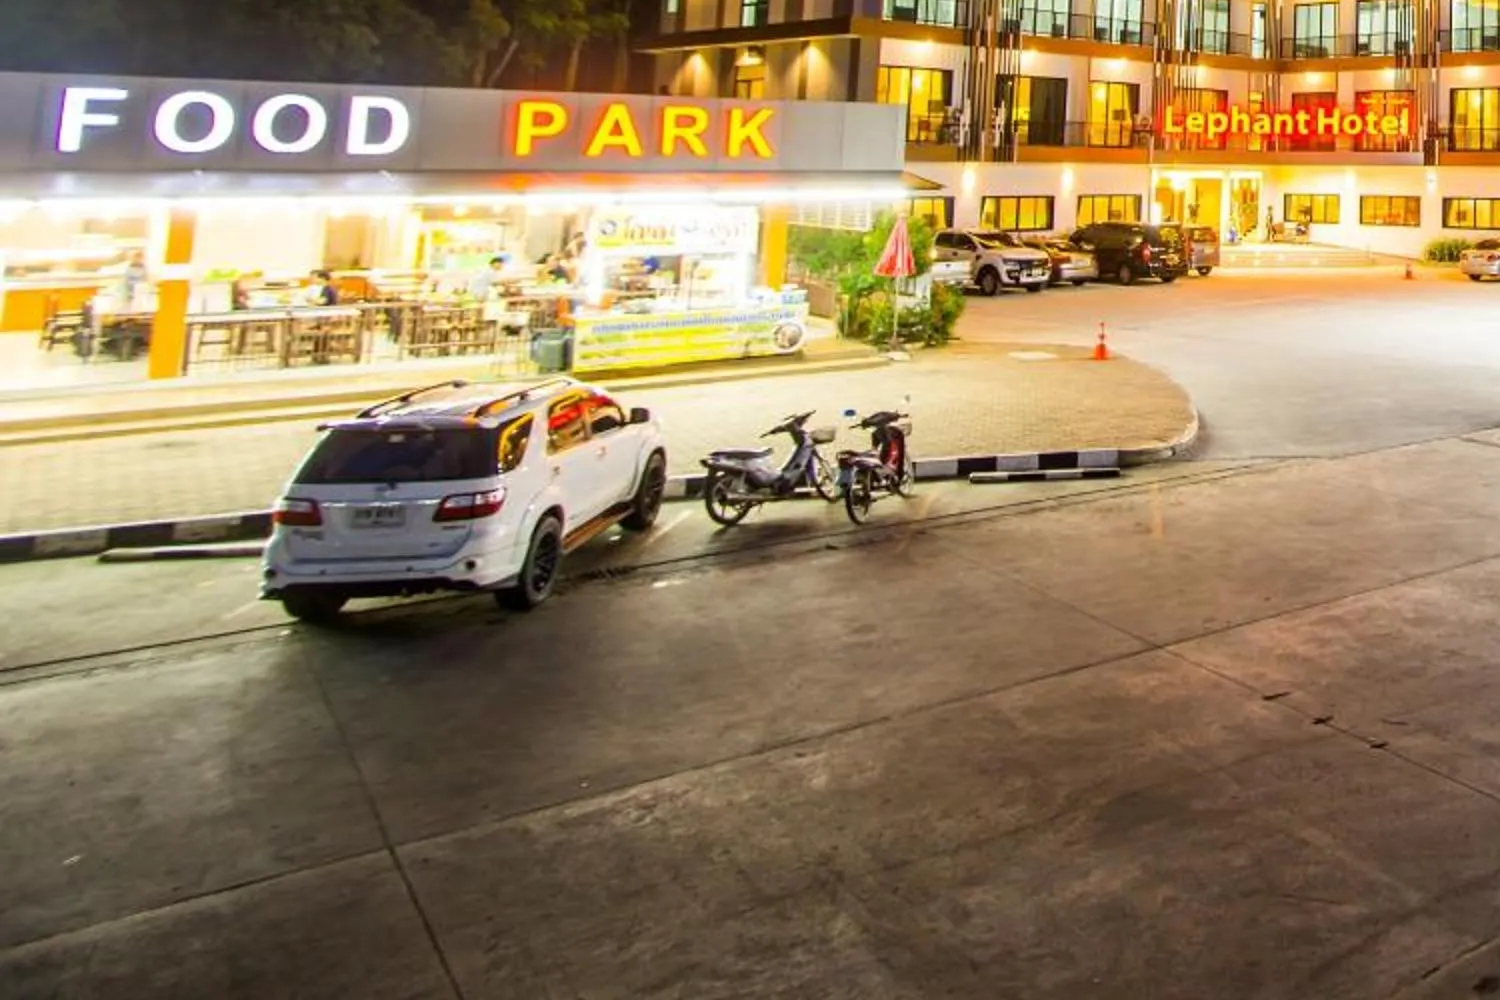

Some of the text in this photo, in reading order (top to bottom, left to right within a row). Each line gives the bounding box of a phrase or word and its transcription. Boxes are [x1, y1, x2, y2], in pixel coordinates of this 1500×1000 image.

[56, 87, 776, 158] FOOD PARK
[1164, 104, 1409, 139] Lephant Hotel
